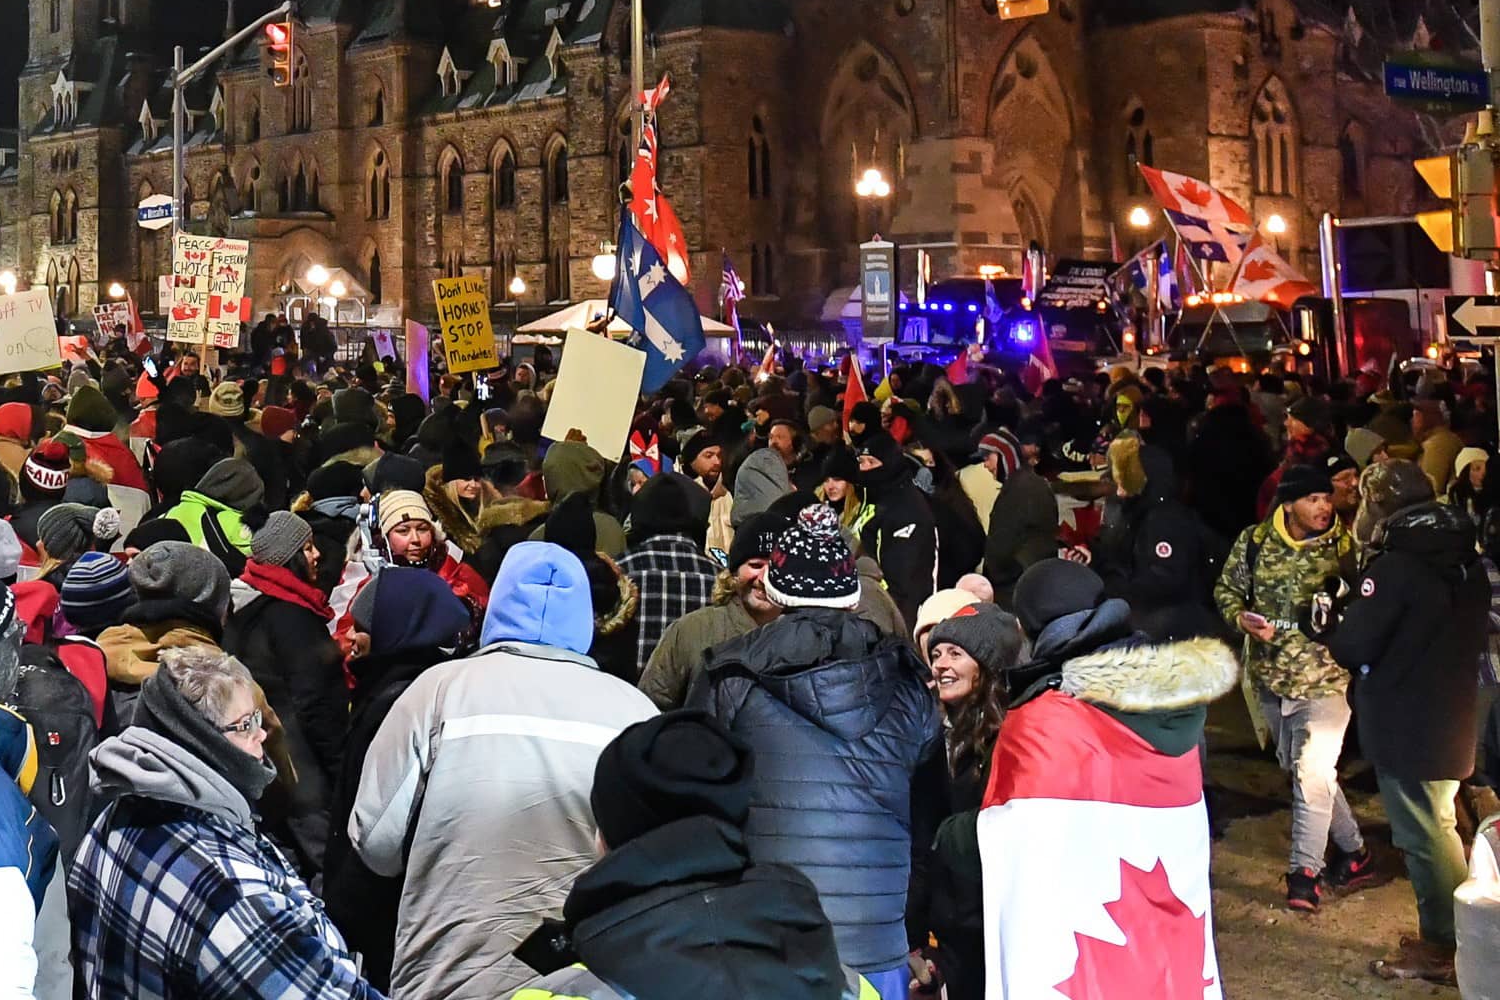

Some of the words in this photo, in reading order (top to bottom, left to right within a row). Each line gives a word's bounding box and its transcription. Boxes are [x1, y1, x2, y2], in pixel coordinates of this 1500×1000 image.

[1408, 69, 1469, 97] Wellington
[174, 262, 213, 278] CHOICE
[27, 297, 43, 313] TV
[449, 321, 484, 343] STOP
[6, 342, 23, 356] on
